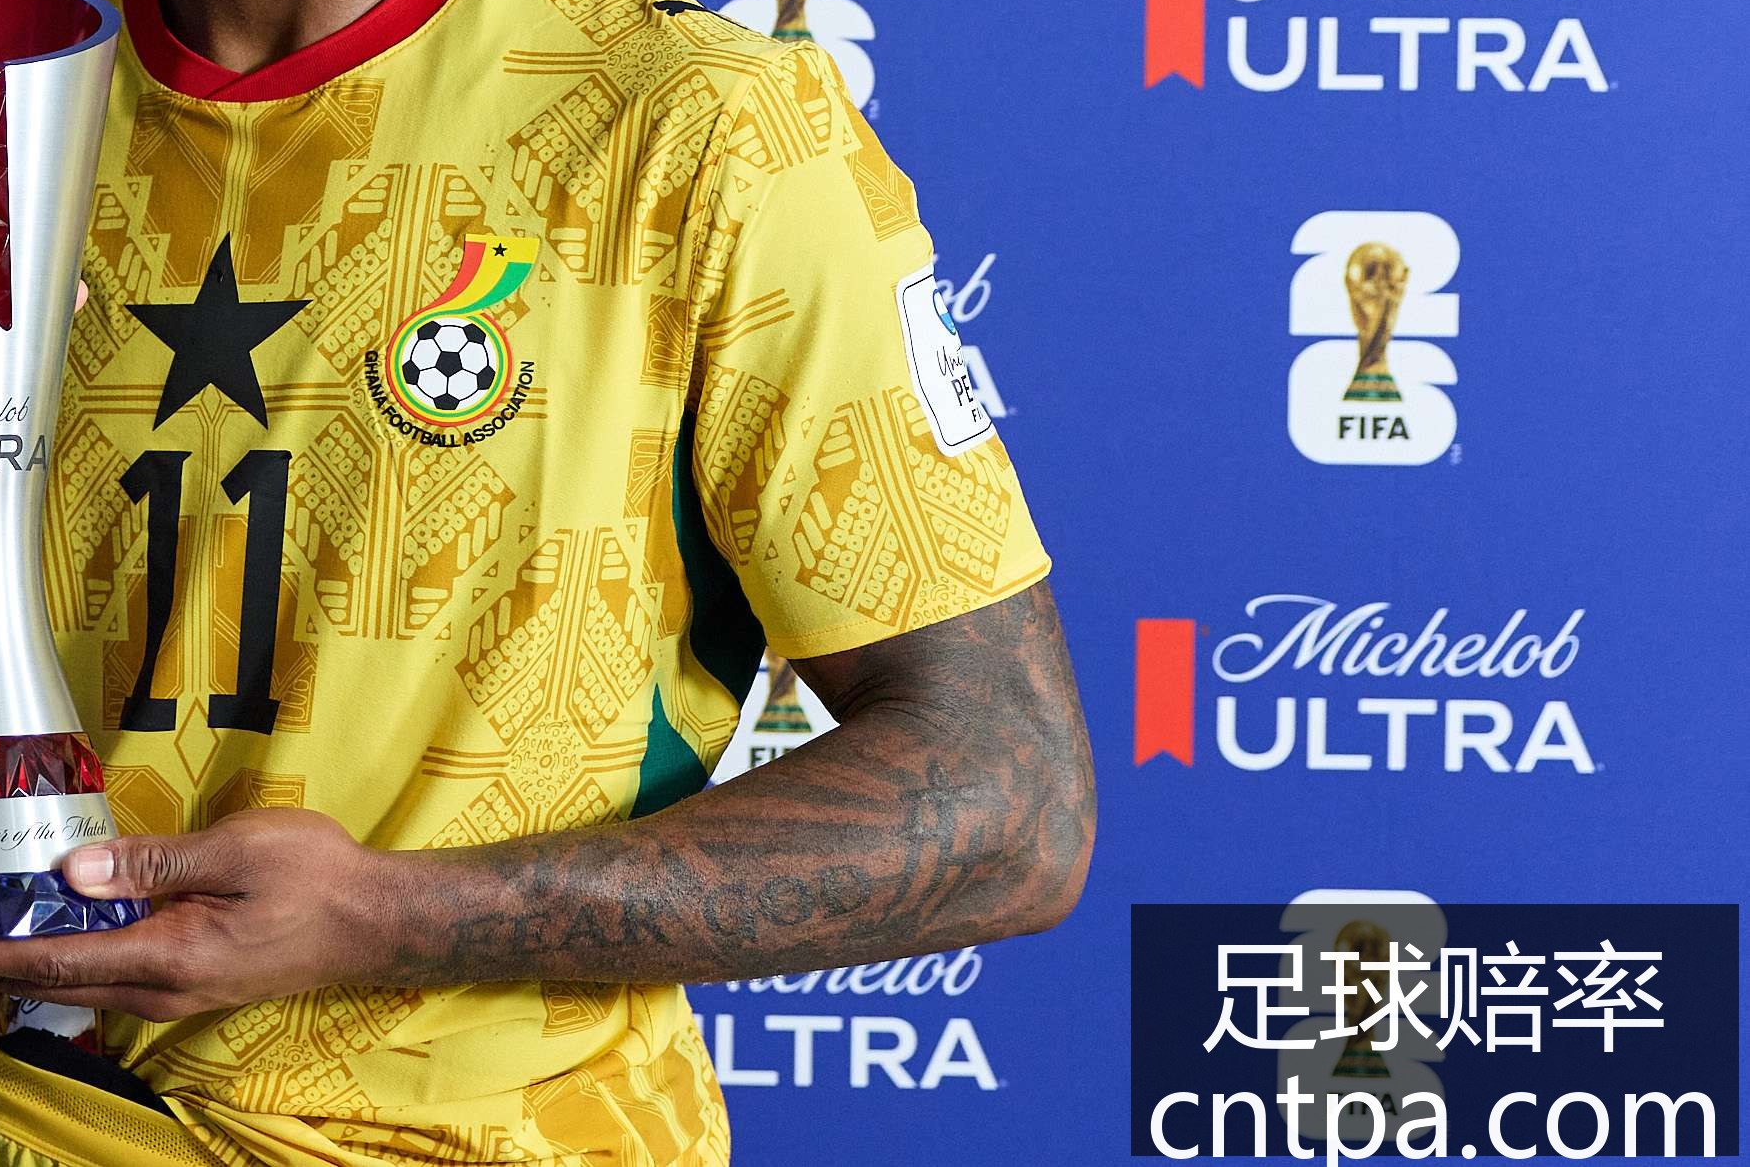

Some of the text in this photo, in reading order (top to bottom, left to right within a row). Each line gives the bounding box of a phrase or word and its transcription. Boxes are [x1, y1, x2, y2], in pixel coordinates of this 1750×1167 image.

[1227, 16, 1610, 93] ULTRA
[364, 349, 535, 448] GHANA FOOTBALL ASSOCIATION
[1338, 416, 1410, 440] FIFA
[120, 449, 292, 735] 11
[1212, 593, 1586, 683] Michelob
[1216, 695, 1596, 775] ULTRA
[1, 821, 33, 851] of
[33, 821, 56, 840] the
[62, 815, 107, 840] Match
[703, 863, 874, 943] GOD
[693, 1013, 999, 1090] LTRA
